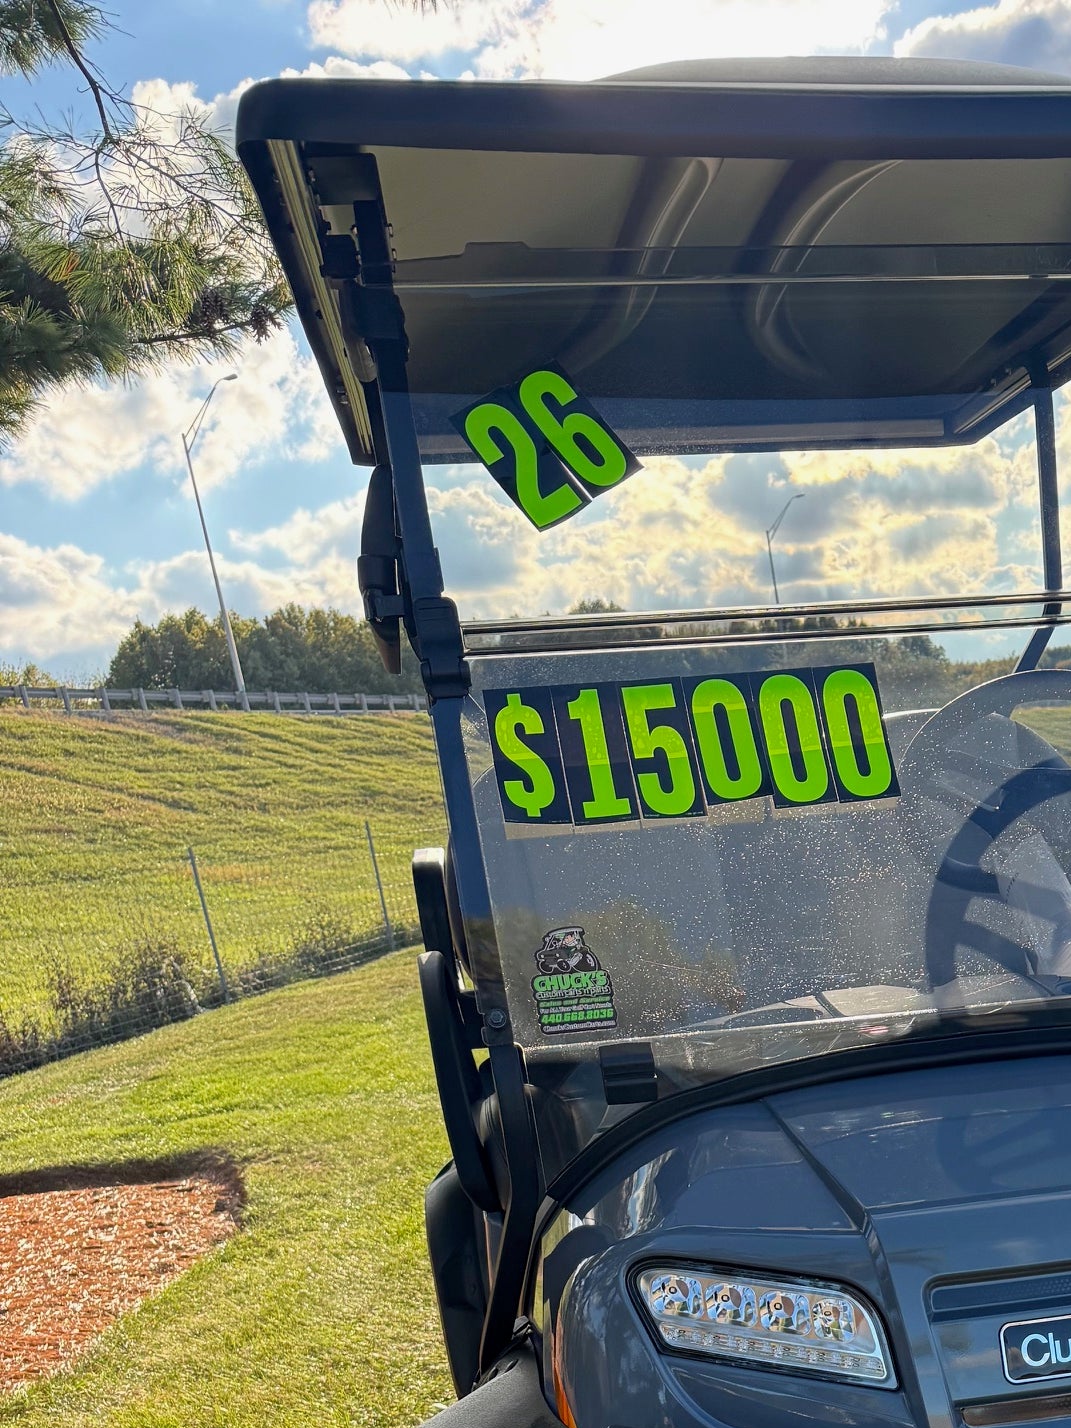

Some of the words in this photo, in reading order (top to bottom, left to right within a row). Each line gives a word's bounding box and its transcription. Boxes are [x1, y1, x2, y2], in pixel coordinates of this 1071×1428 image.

[465, 370, 627, 528] 26
[494, 669, 892, 819] $15000
[533, 970, 607, 992] CHUCK'S
[541, 1008, 614, 1024] 440.668.8036
